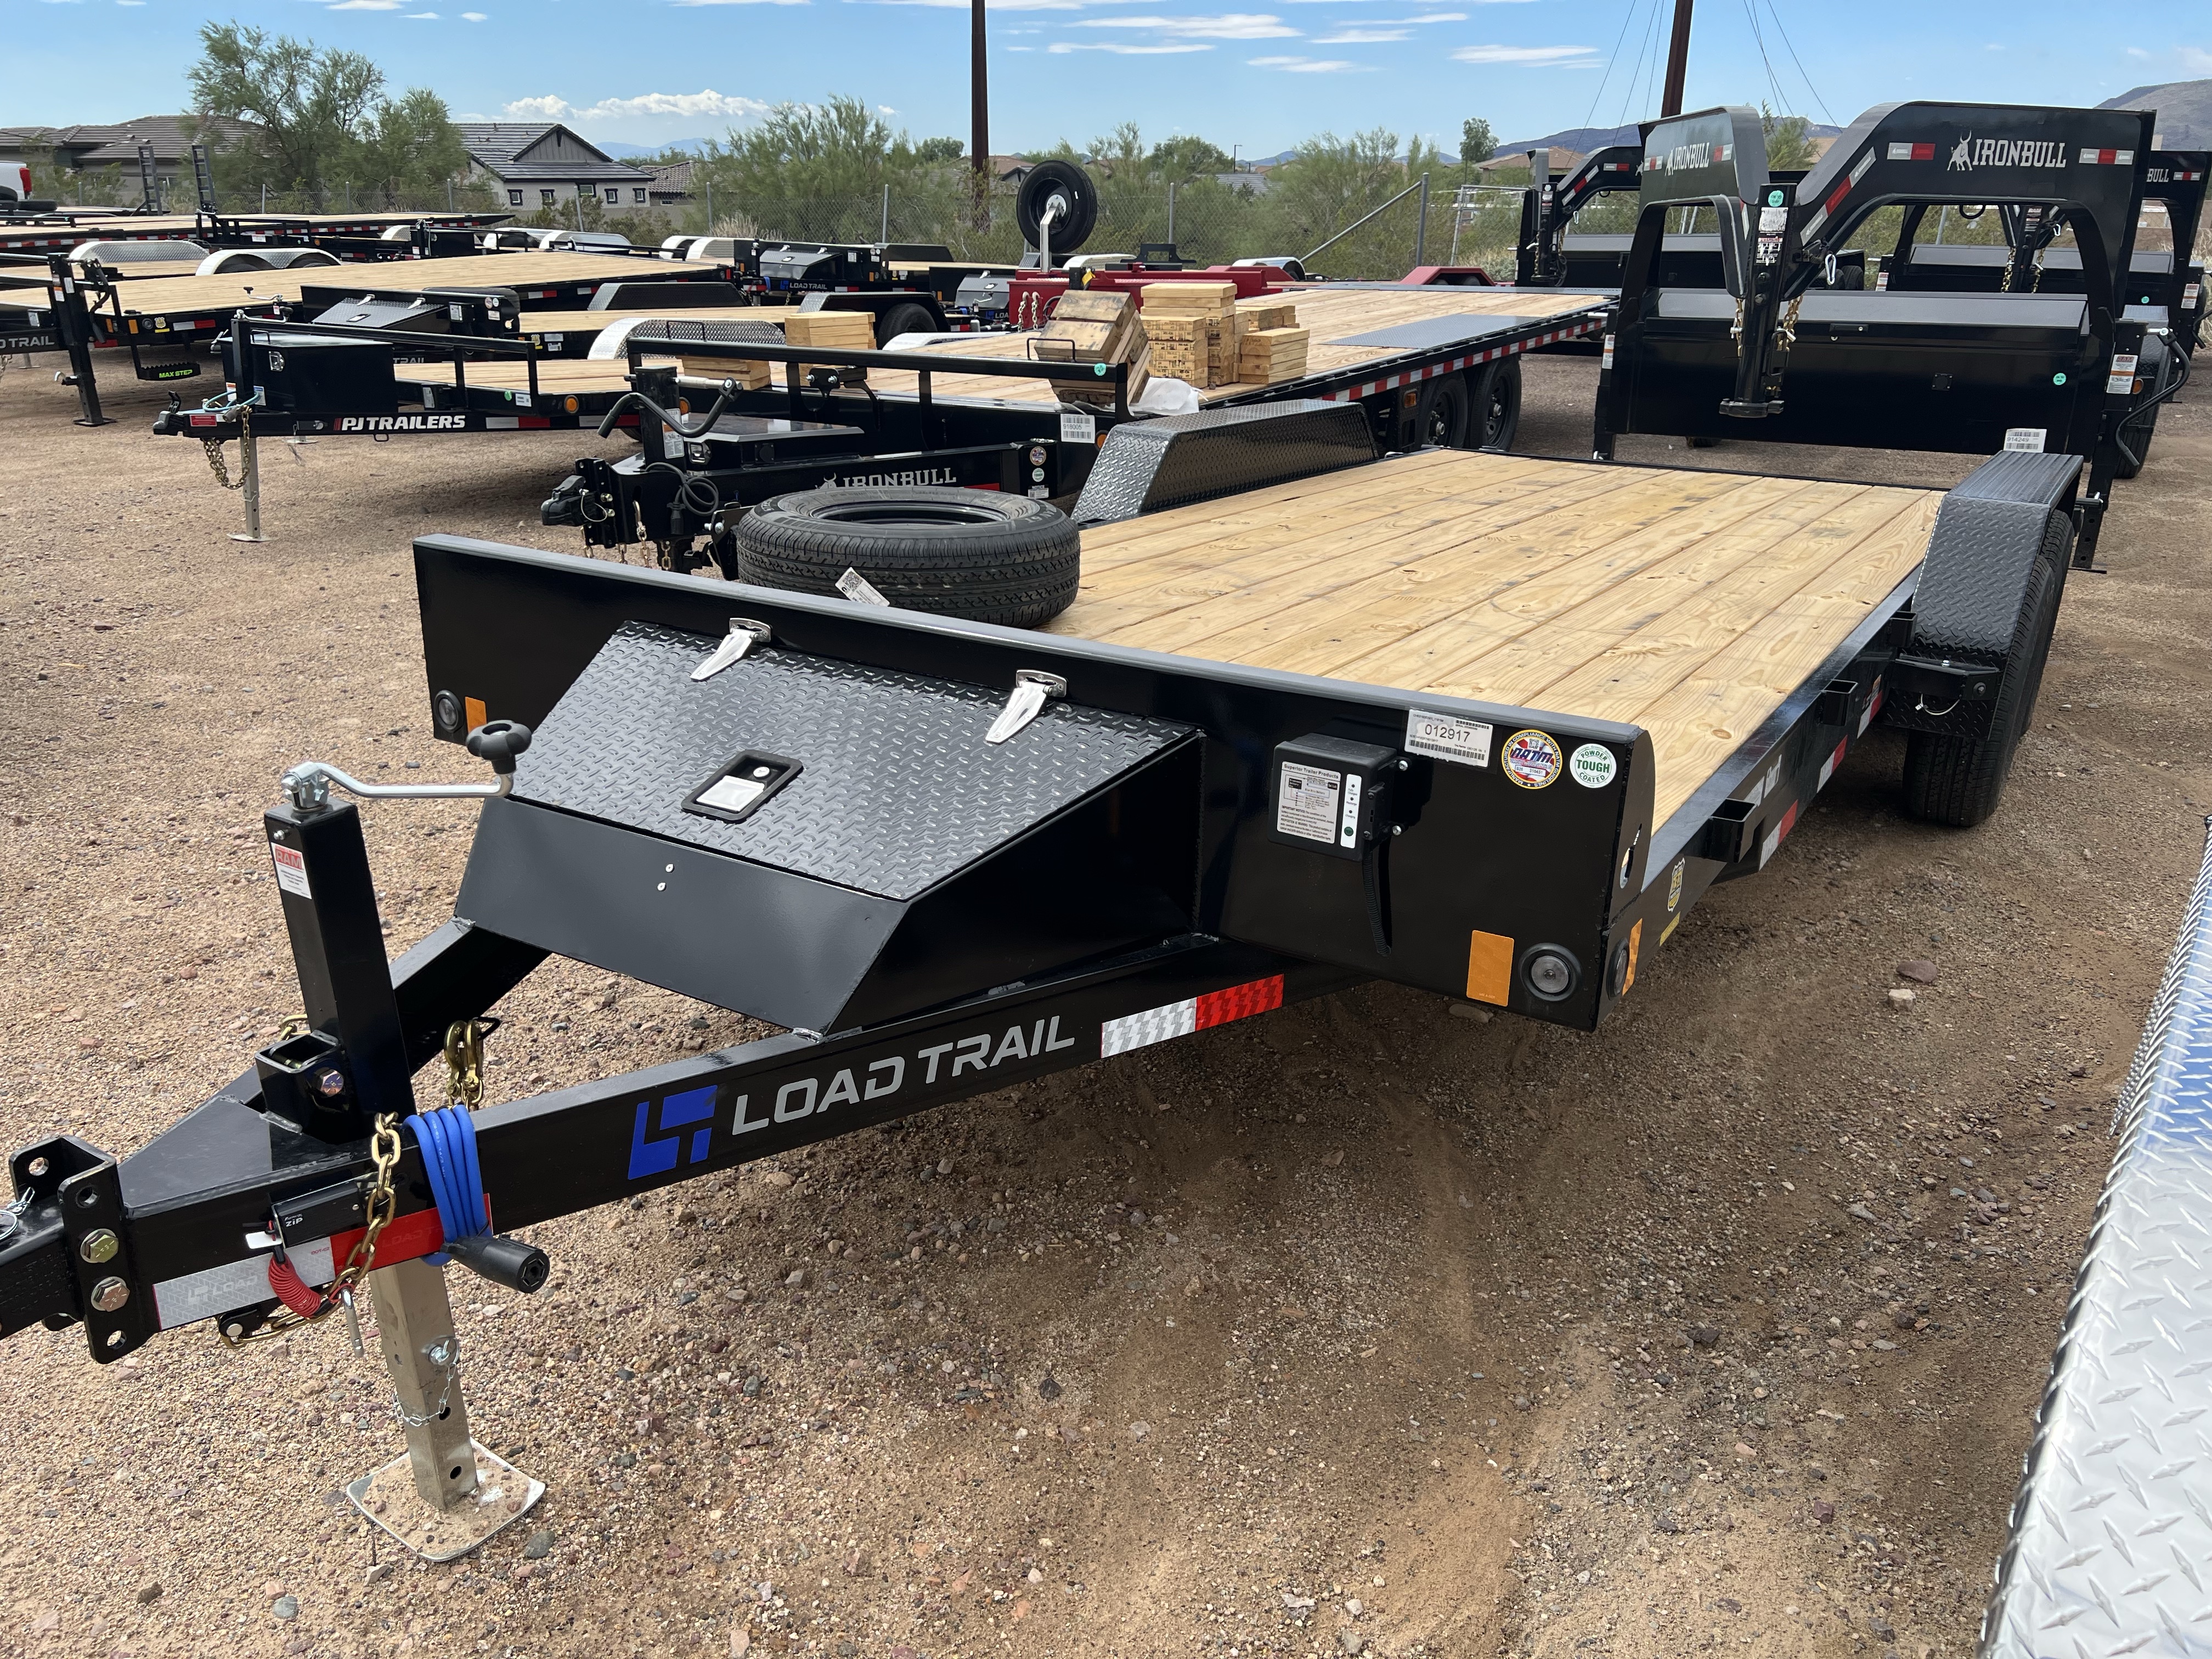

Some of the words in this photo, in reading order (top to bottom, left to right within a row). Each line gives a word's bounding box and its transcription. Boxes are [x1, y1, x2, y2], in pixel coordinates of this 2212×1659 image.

[1673, 142, 1710, 170] IRONBULL
[1972, 139, 2067, 168] IRONBULL
[2147, 168, 2169, 183] BULL
[8, 336, 55, 348] TRAIL
[342, 417, 364, 431] PJ
[366, 415, 466, 431] TRAILERS
[843, 467, 957, 487] IRONBULL
[1425, 724, 1470, 742] 012917
[1513, 732, 1546, 742] COMPLIANCE
[1546, 738, 1557, 752] WITH
[1581, 751, 1608, 761] POWDER
[1504, 747, 1523, 785] MANUFACTURED
[1576, 759, 1610, 773] TOUGH
[1318, 771, 1339, 779] Products
[1534, 768, 1559, 787] GUIDELINES
[1579, 772, 1605, 782] COATED
[276, 849, 302, 870] RAM
[732, 1056, 905, 1136] LOAD
[918, 1015, 1075, 1084] TRAIL
